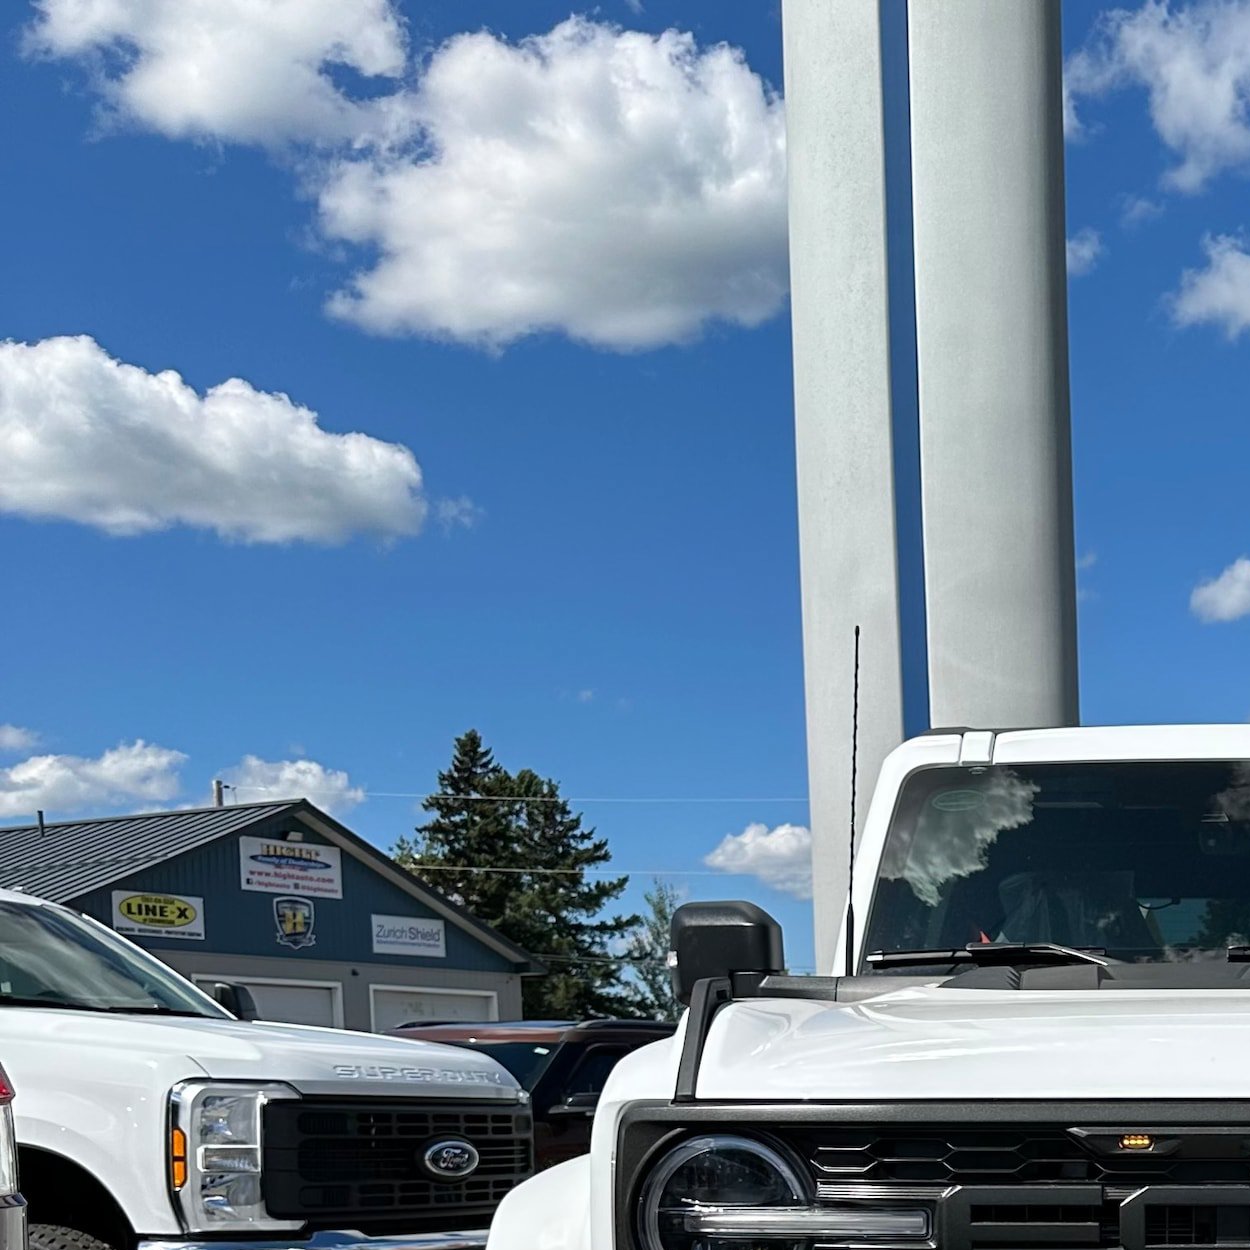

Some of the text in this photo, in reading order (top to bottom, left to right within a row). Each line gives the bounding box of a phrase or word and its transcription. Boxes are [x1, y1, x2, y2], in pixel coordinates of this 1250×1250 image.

[126, 903, 189, 919] LINE-X
[376, 925, 441, 942] Zurich Shield
[333, 1065, 439, 1081] SUPER
[440, 1148, 469, 1168] Ford
